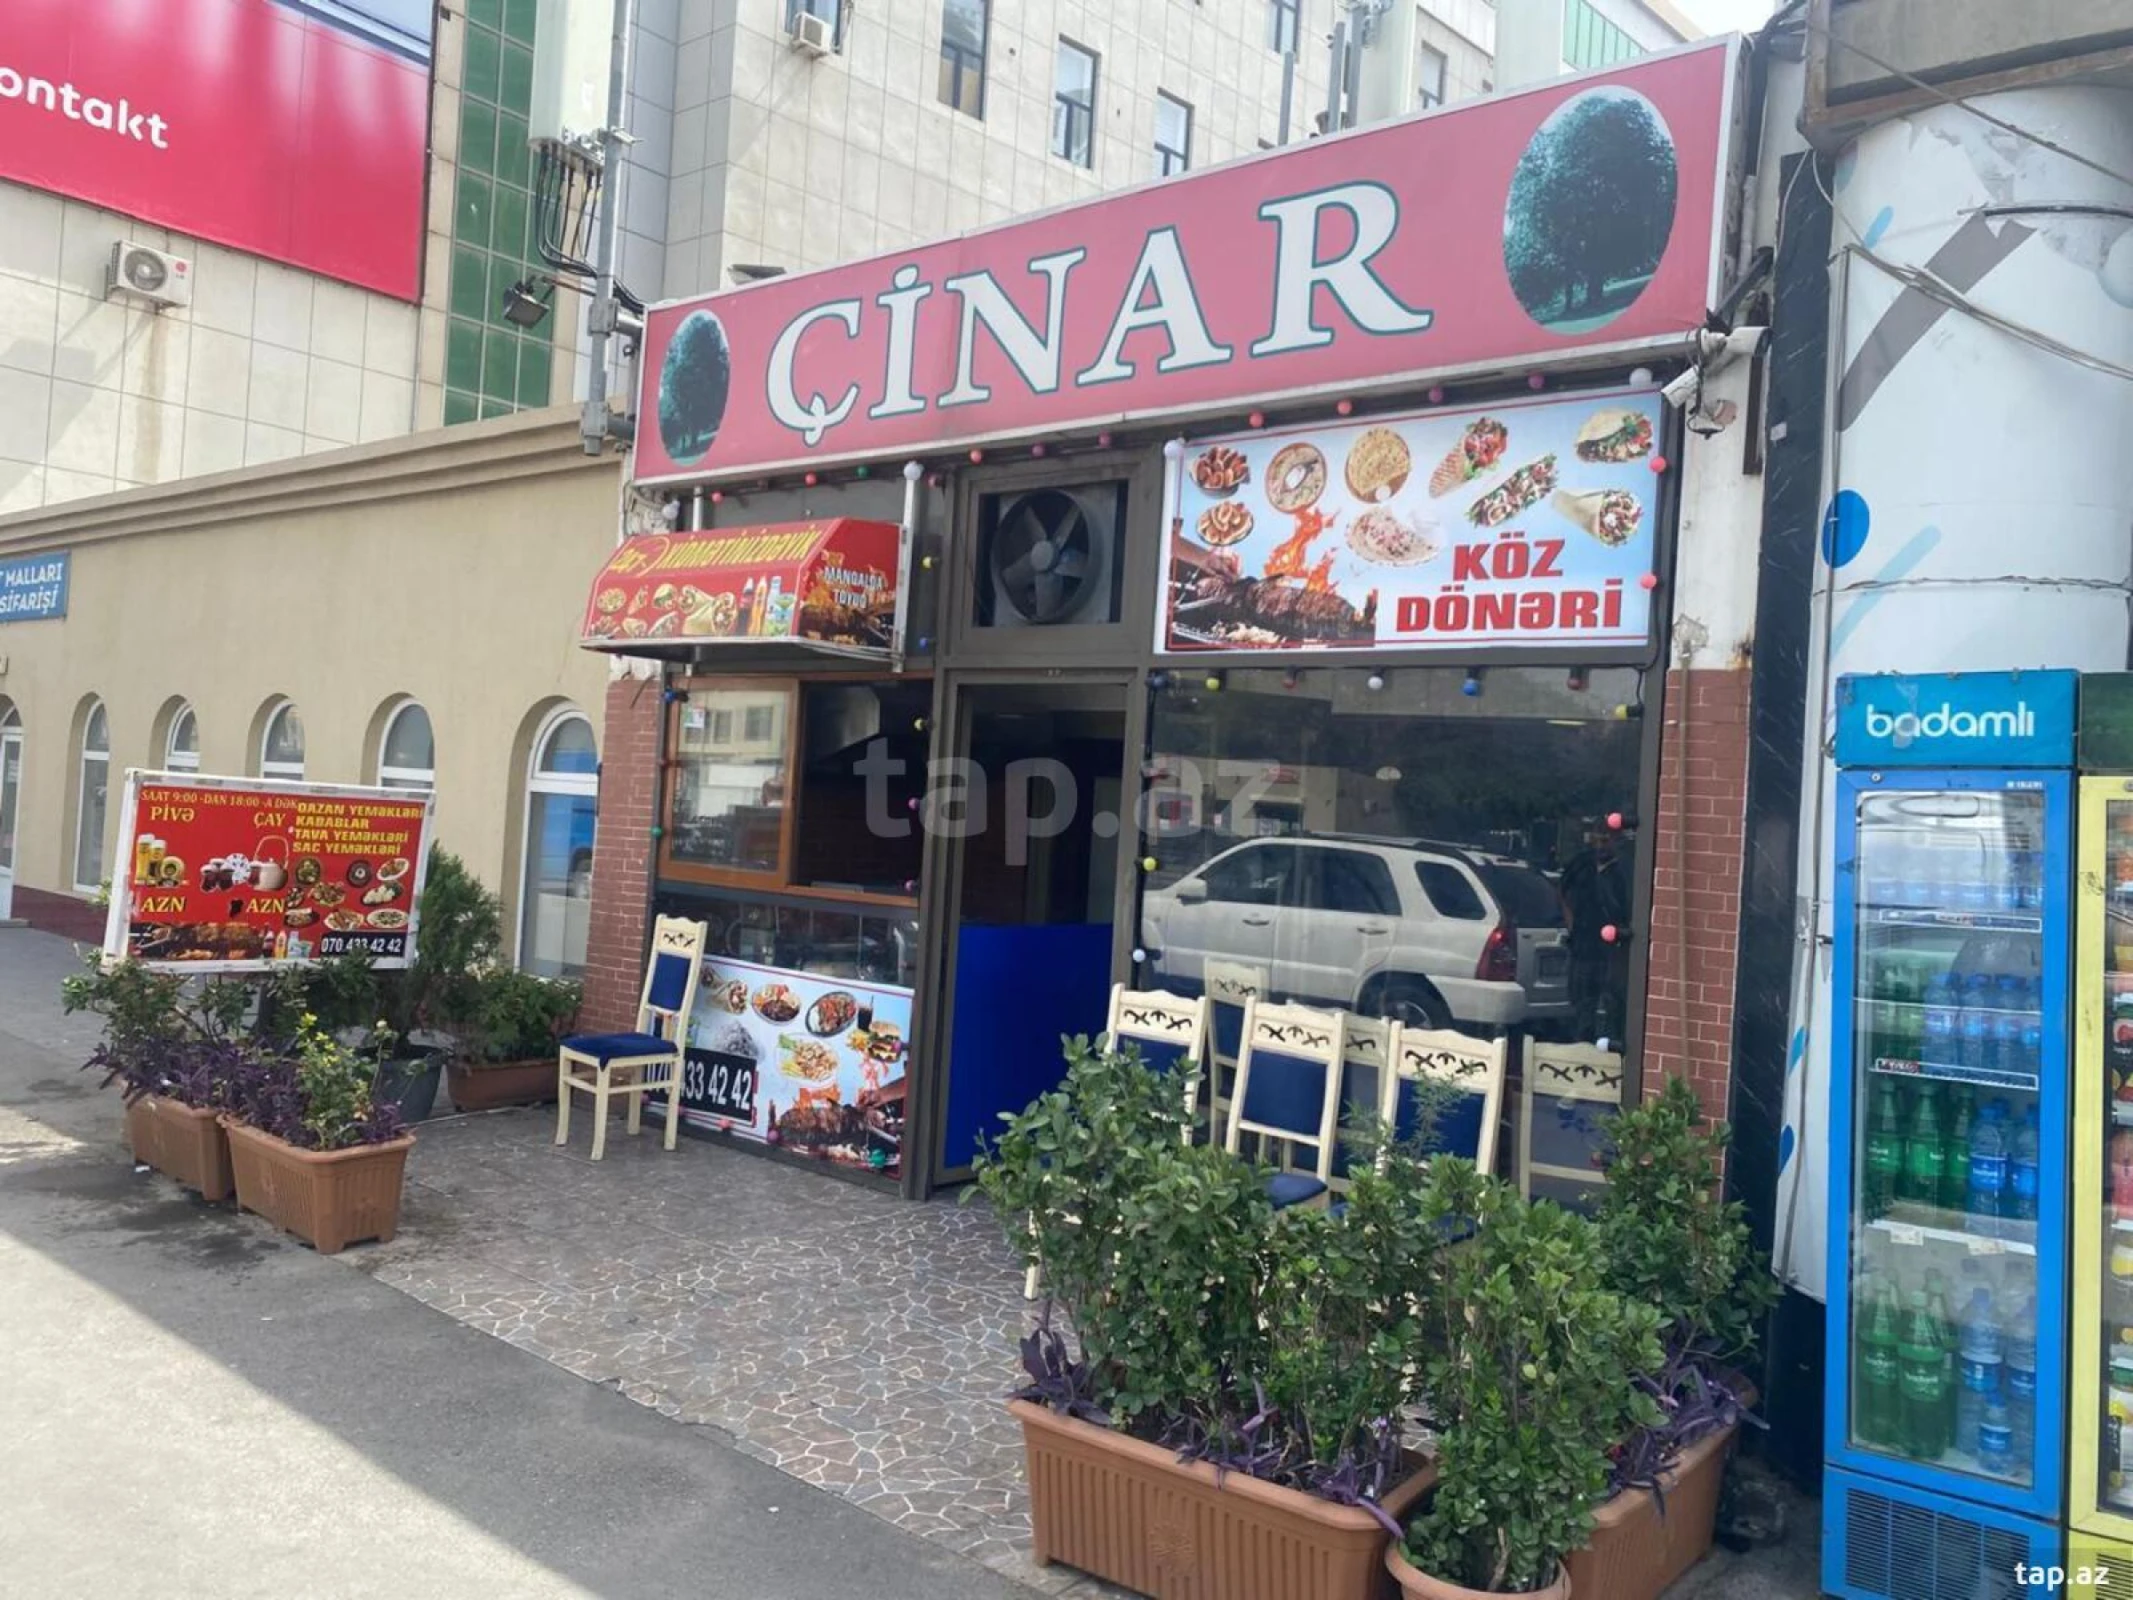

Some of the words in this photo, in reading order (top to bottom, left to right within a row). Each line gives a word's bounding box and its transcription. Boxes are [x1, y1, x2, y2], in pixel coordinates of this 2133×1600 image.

[764, 179, 1434, 447] ÇİNAR
[1452, 531, 1566, 582] KÖZ
[5, 562, 63, 588] MALLARI
[1396, 578, 1624, 632] DÖNƏRİ
[1865, 701, 2035, 738] badamlı
[140, 790, 170, 801] SAAT
[172, 792, 198, 803] 9:00
[230, 795, 260, 807] 18:00
[150, 804, 195, 822] PİVƏ
[253, 812, 286, 829] ÇAY
[295, 815, 370, 829] KABABLAR
[294, 828, 329, 840] TAVA
[334, 829, 409, 843] YEMƏKLƏRİ
[292, 841, 321, 853] SAC
[325, 842, 400, 855] YEMƏKLƏRİ
[141, 896, 186, 913] AZN
[246, 898, 285, 914] AZN
[321, 937, 344, 953] 070
[370, 938, 386, 953] 42
[387, 938, 402, 953] 42
[680, 1060, 705, 1100] 33
[707, 1063, 729, 1105] 42
[730, 1068, 753, 1111] 42
